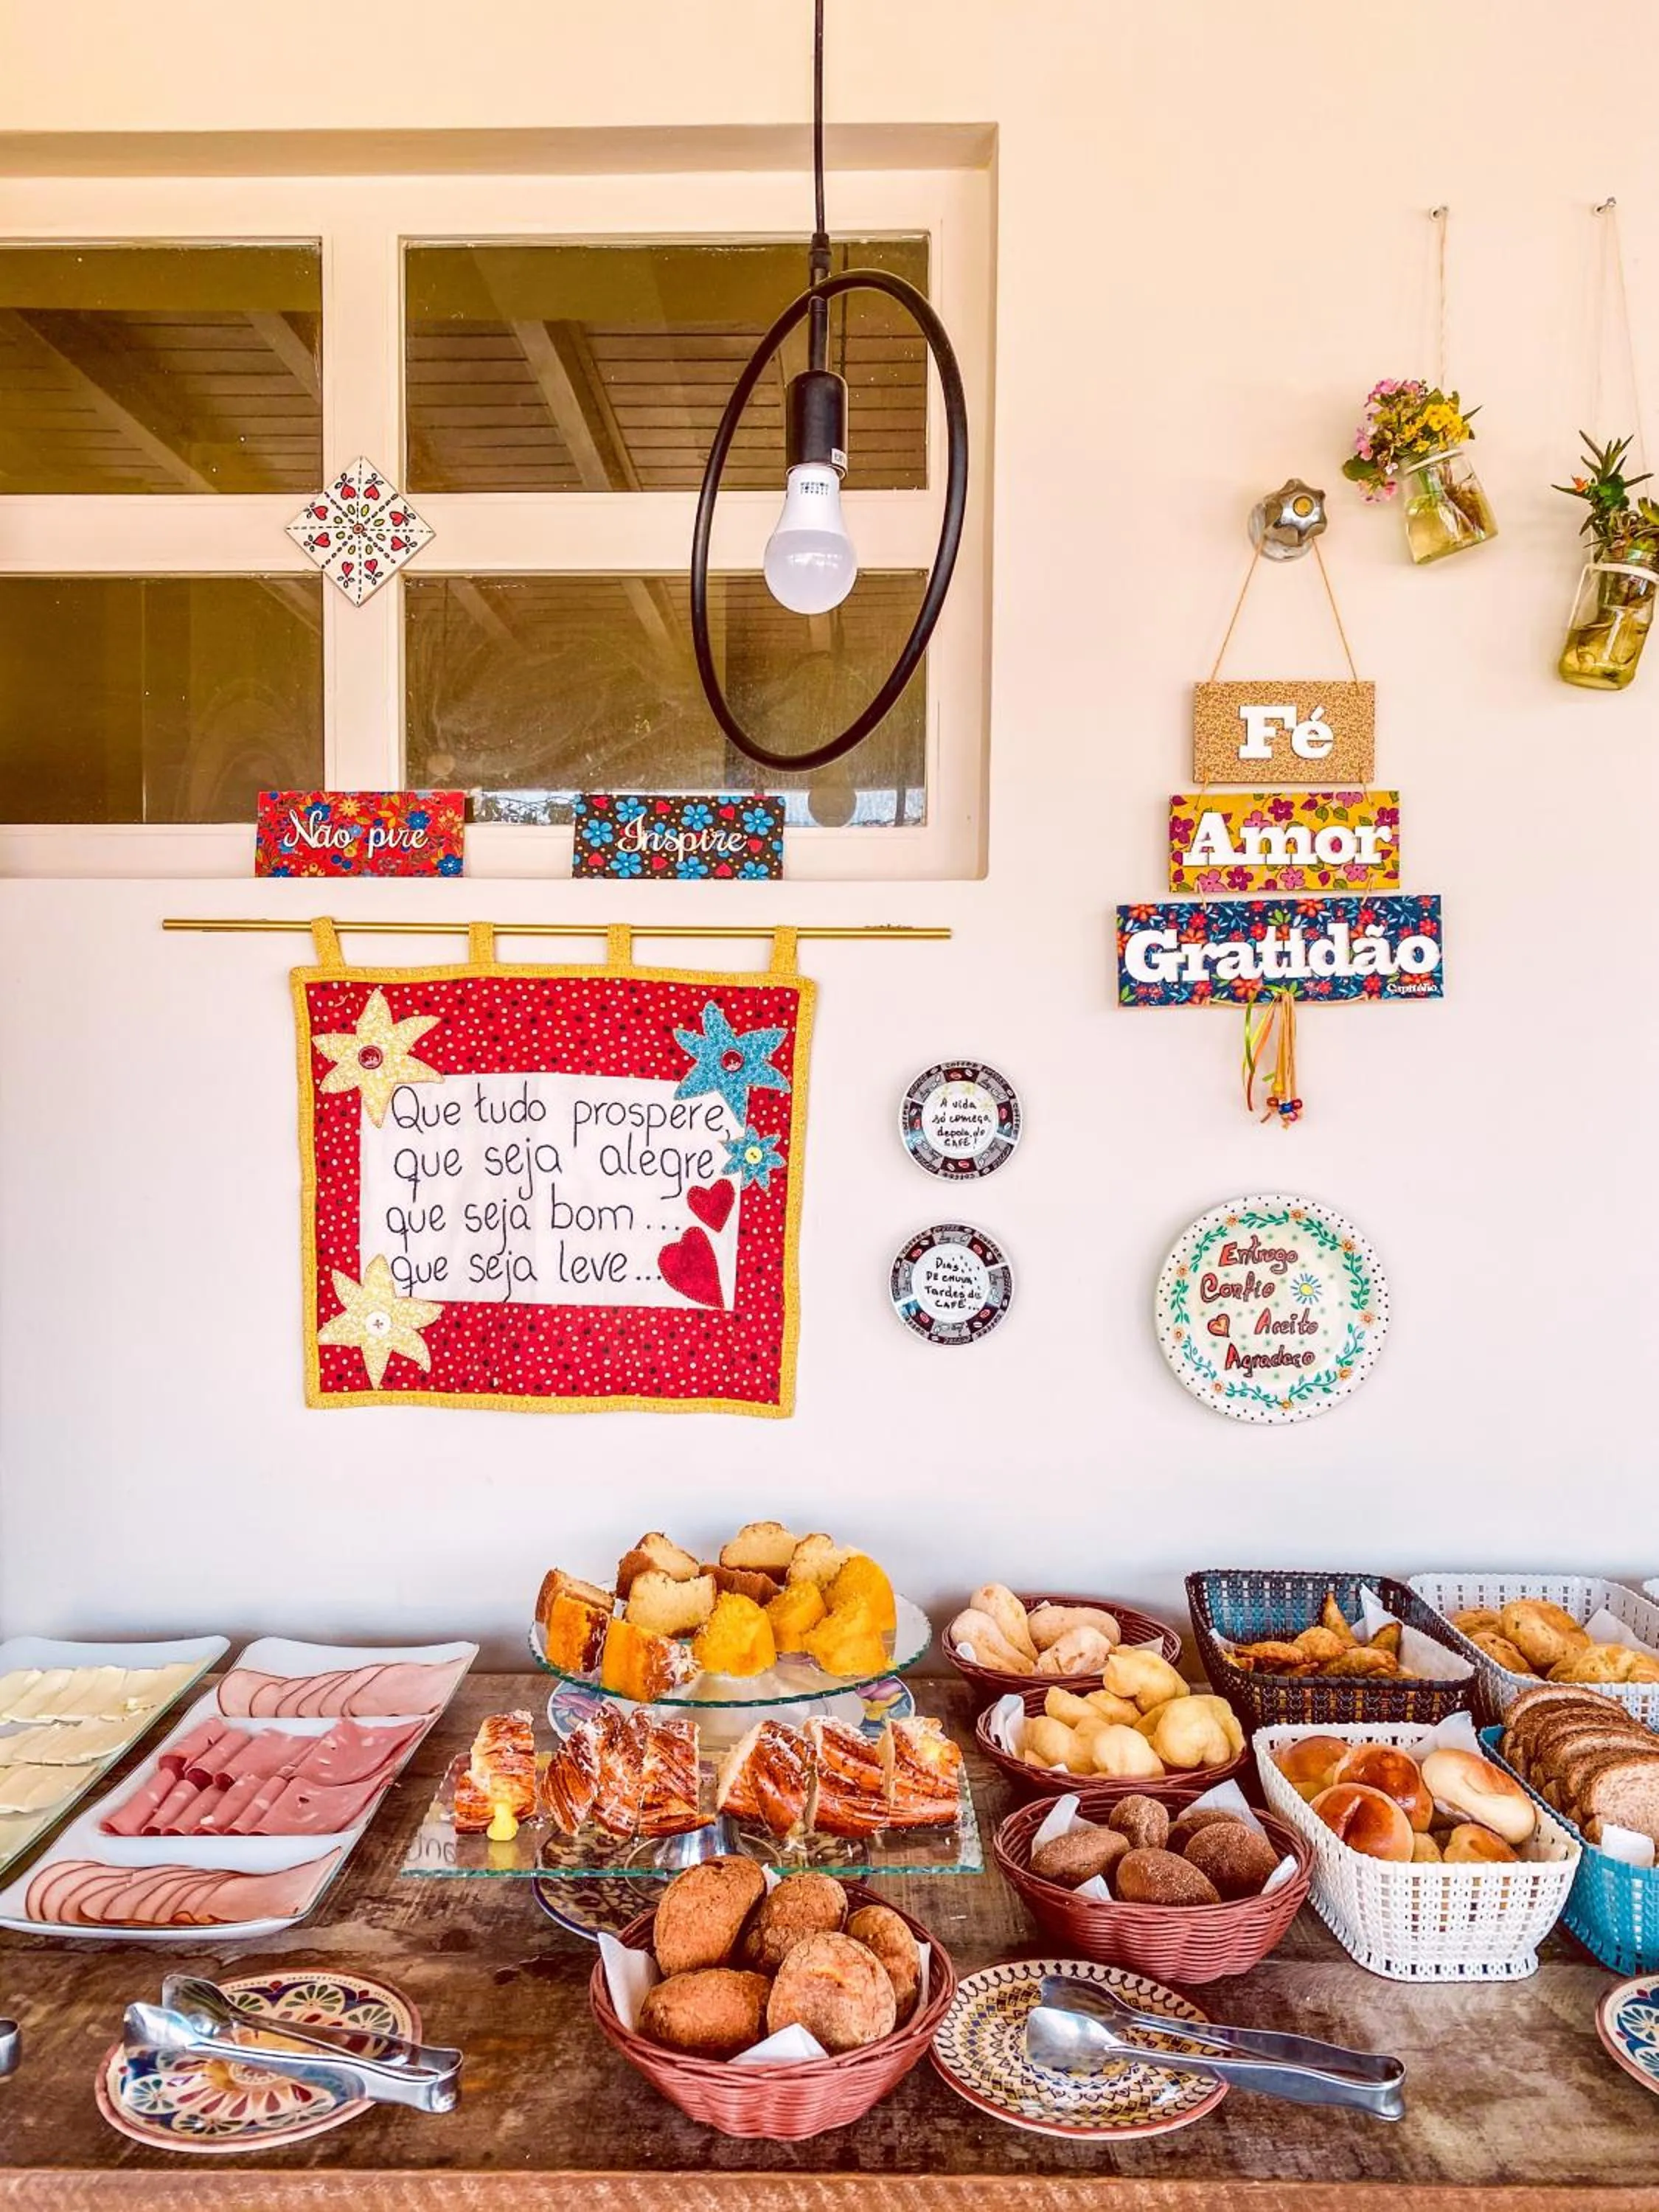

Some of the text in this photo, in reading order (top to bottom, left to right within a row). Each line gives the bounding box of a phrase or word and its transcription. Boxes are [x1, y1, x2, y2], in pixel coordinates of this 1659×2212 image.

[1238, 705, 1334, 759] Fé
[284, 809, 428, 859] Não pire
[616, 813, 748, 861] Inspire
[1183, 811, 1392, 866] Amor
[1124, 922, 1441, 983] Gratidão
[392, 1080, 730, 1147] Que tudo prospere,
[940, 1097, 977, 1109] A vida
[949, 1114, 991, 1124] começa
[394, 1133, 714, 1202] que seja alegre
[386, 1206, 446, 1253] que
[464, 1199, 531, 1255] seja
[391, 1255, 448, 1297] que
[468, 1251, 538, 1302] seja
[1218, 1234, 1298, 1274] Entrego
[925, 1285, 965, 1298] Tardes
[1200, 1271, 1276, 1304] Confio
[1254, 1307, 1319, 1335] Aceito
[1224, 1343, 1315, 1378] Agradeço
